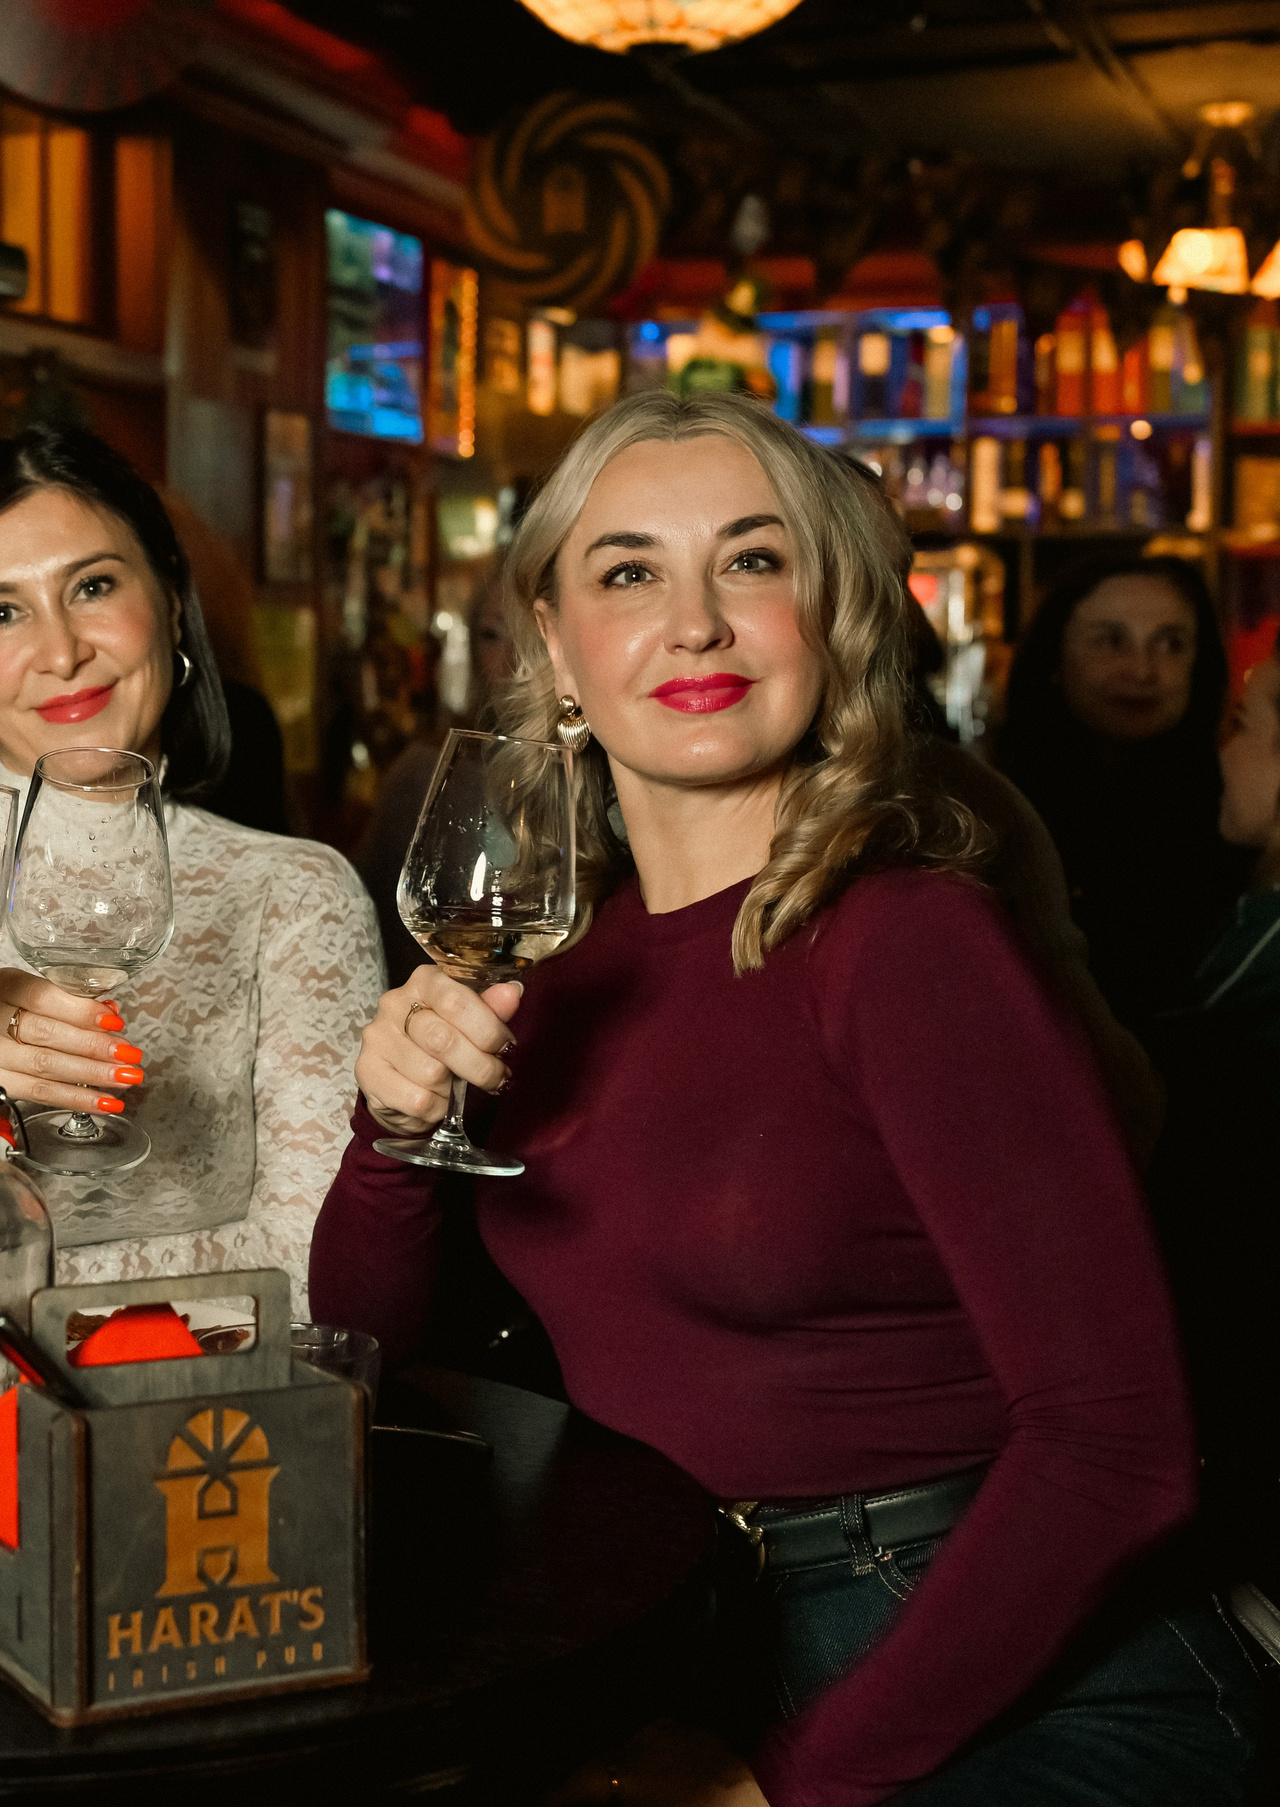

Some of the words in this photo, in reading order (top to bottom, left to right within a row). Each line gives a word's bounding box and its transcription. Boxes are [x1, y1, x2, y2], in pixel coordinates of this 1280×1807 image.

[108, 1586, 325, 1660] HARAT'S
[108, 1655, 227, 1692] IRISH
[256, 1642, 324, 1670] PUB
